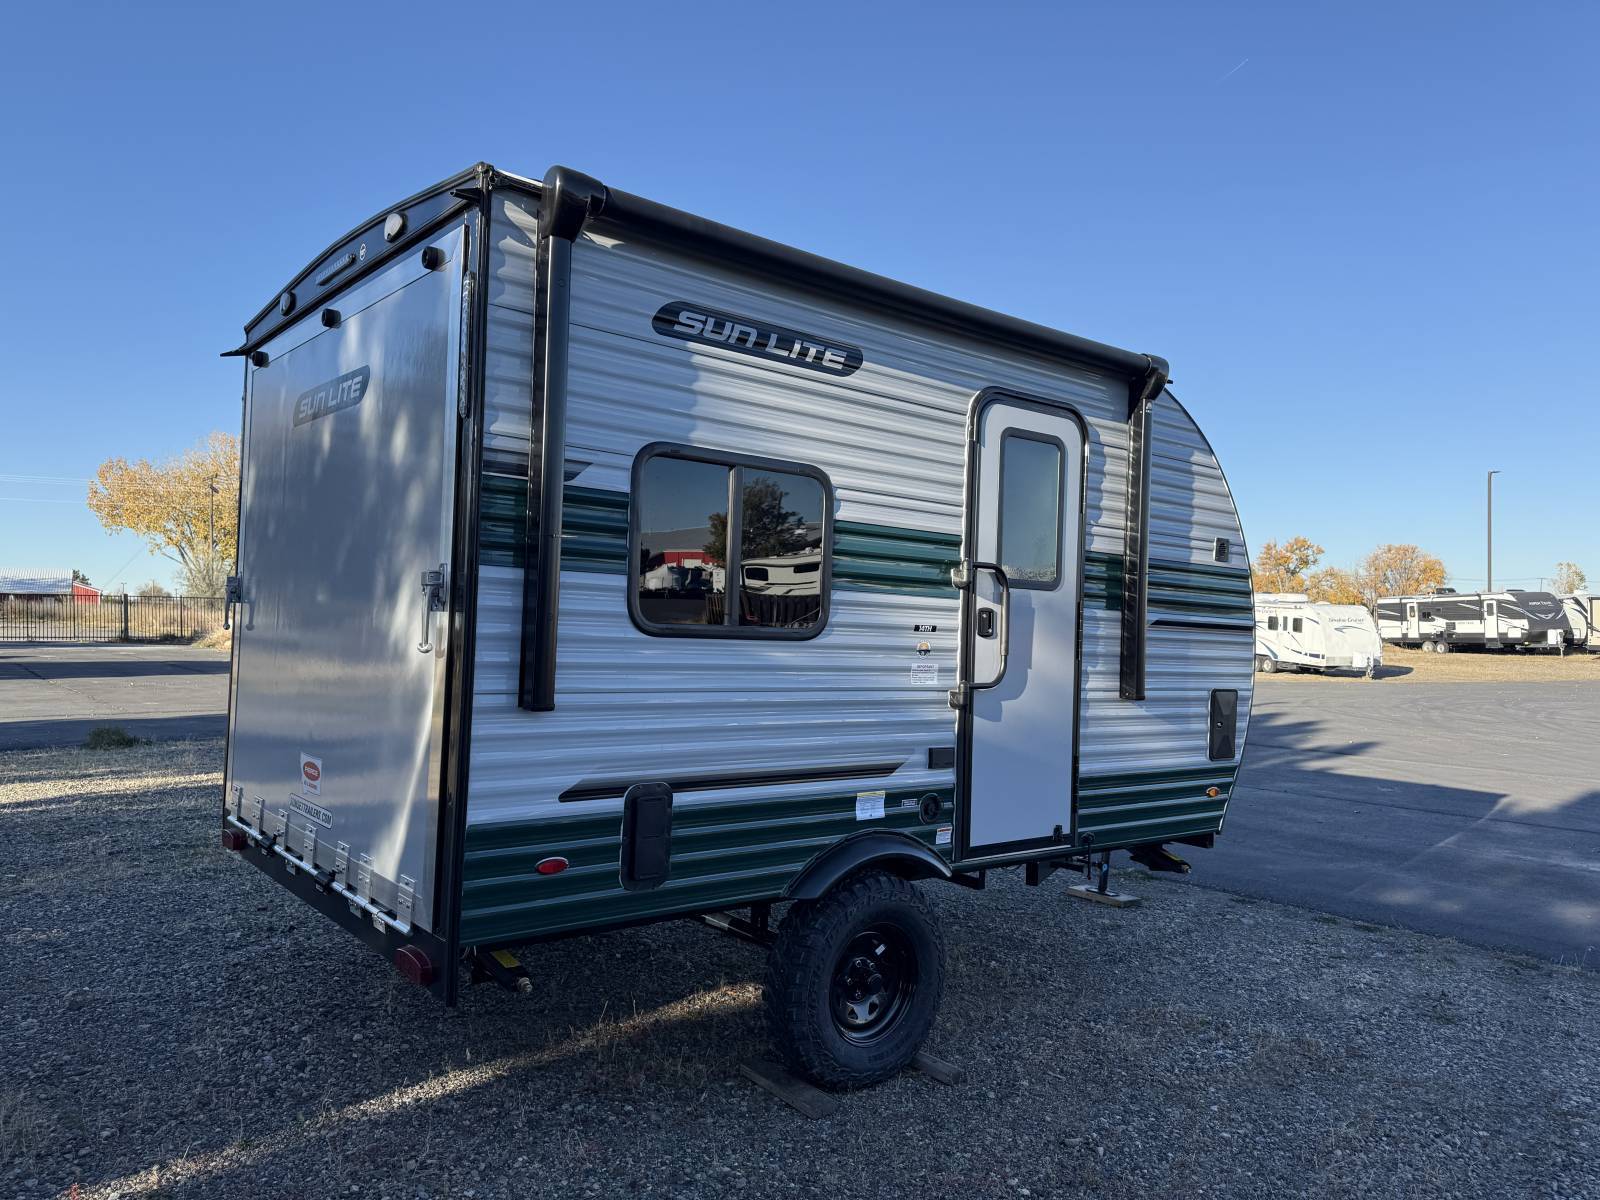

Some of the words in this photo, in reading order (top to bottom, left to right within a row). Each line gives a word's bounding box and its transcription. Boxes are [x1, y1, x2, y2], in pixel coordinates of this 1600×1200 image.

[674, 310, 758, 348] SUN
[765, 333, 847, 370] LITE
[299, 391, 326, 418] SUN
[328, 375, 363, 408] LITE
